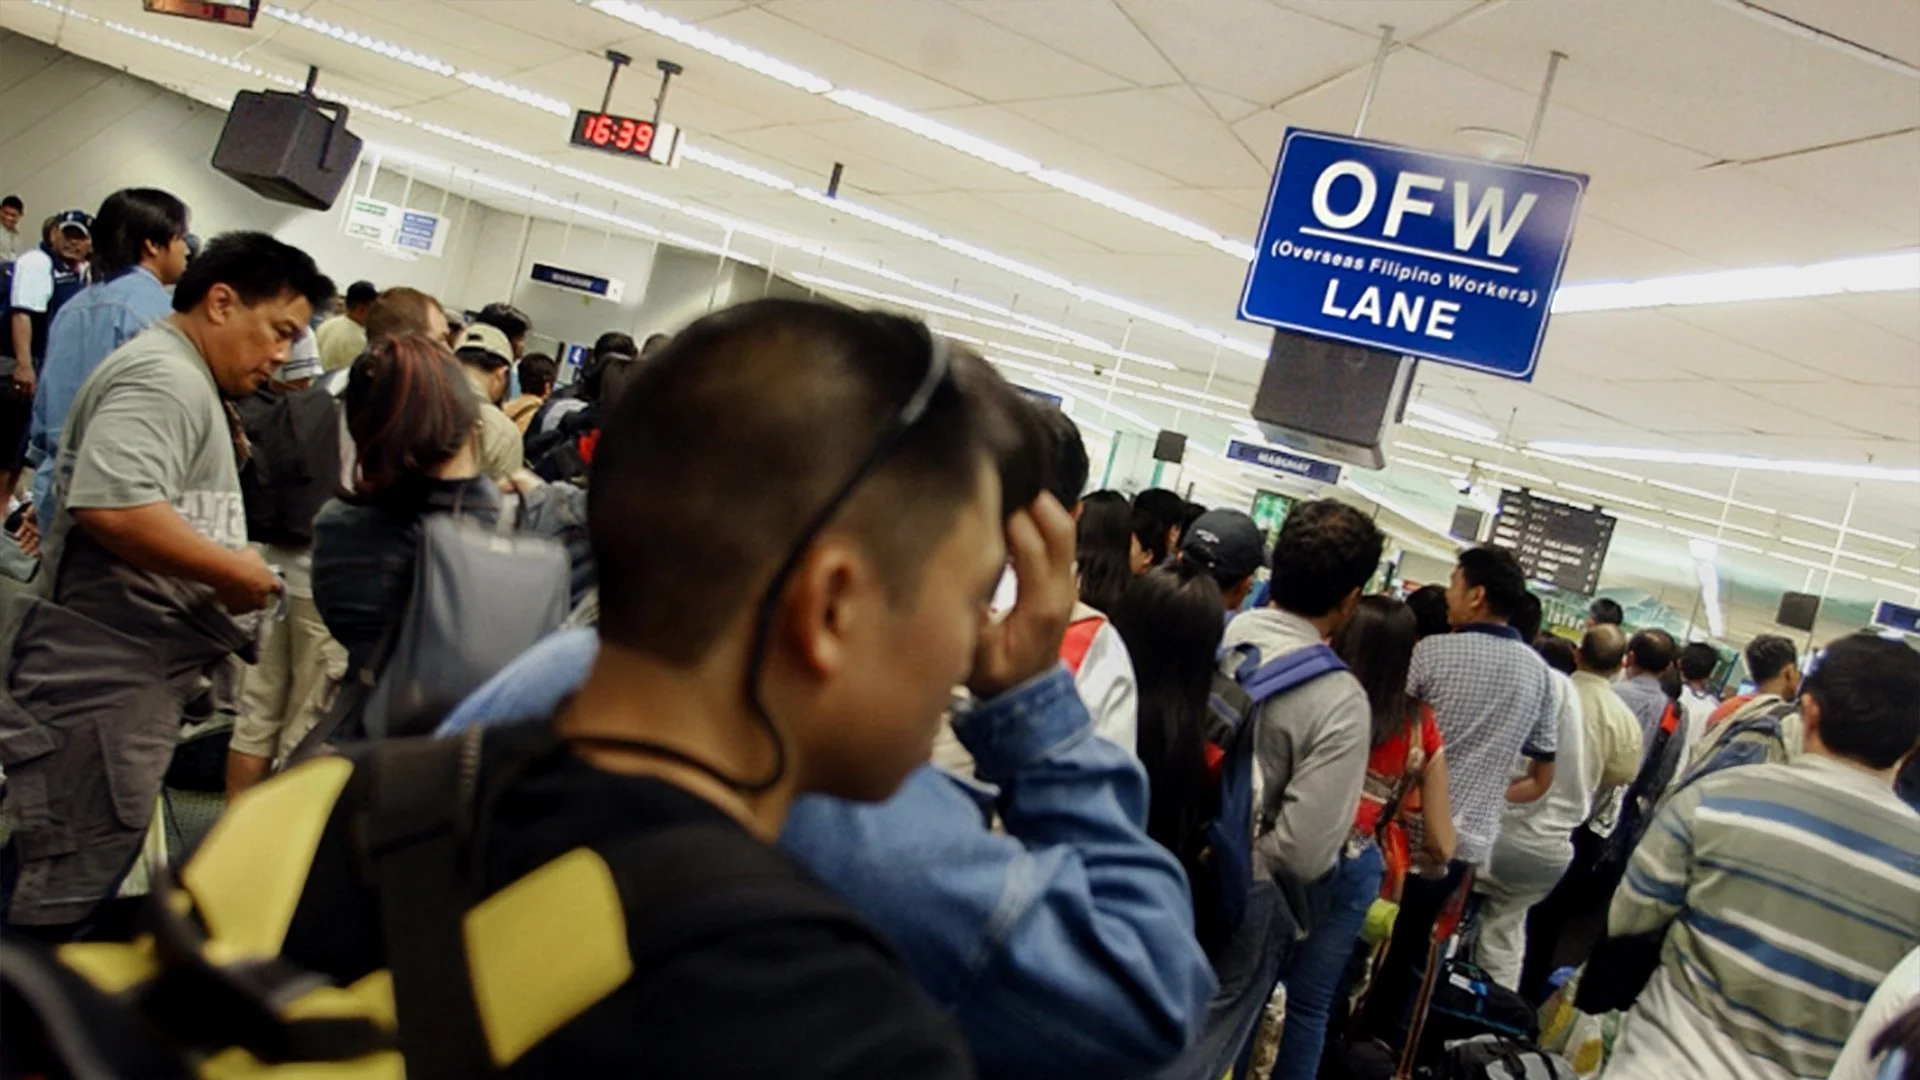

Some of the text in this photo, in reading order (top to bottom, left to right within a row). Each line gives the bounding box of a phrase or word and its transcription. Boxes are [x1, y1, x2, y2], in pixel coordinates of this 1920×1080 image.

[583, 114, 653, 152] 16:39
[1311, 160, 1538, 257] OFW
[1271, 240, 1538, 308] (Overseas Filipino Workers)
[1321, 278, 1462, 340] LANE
